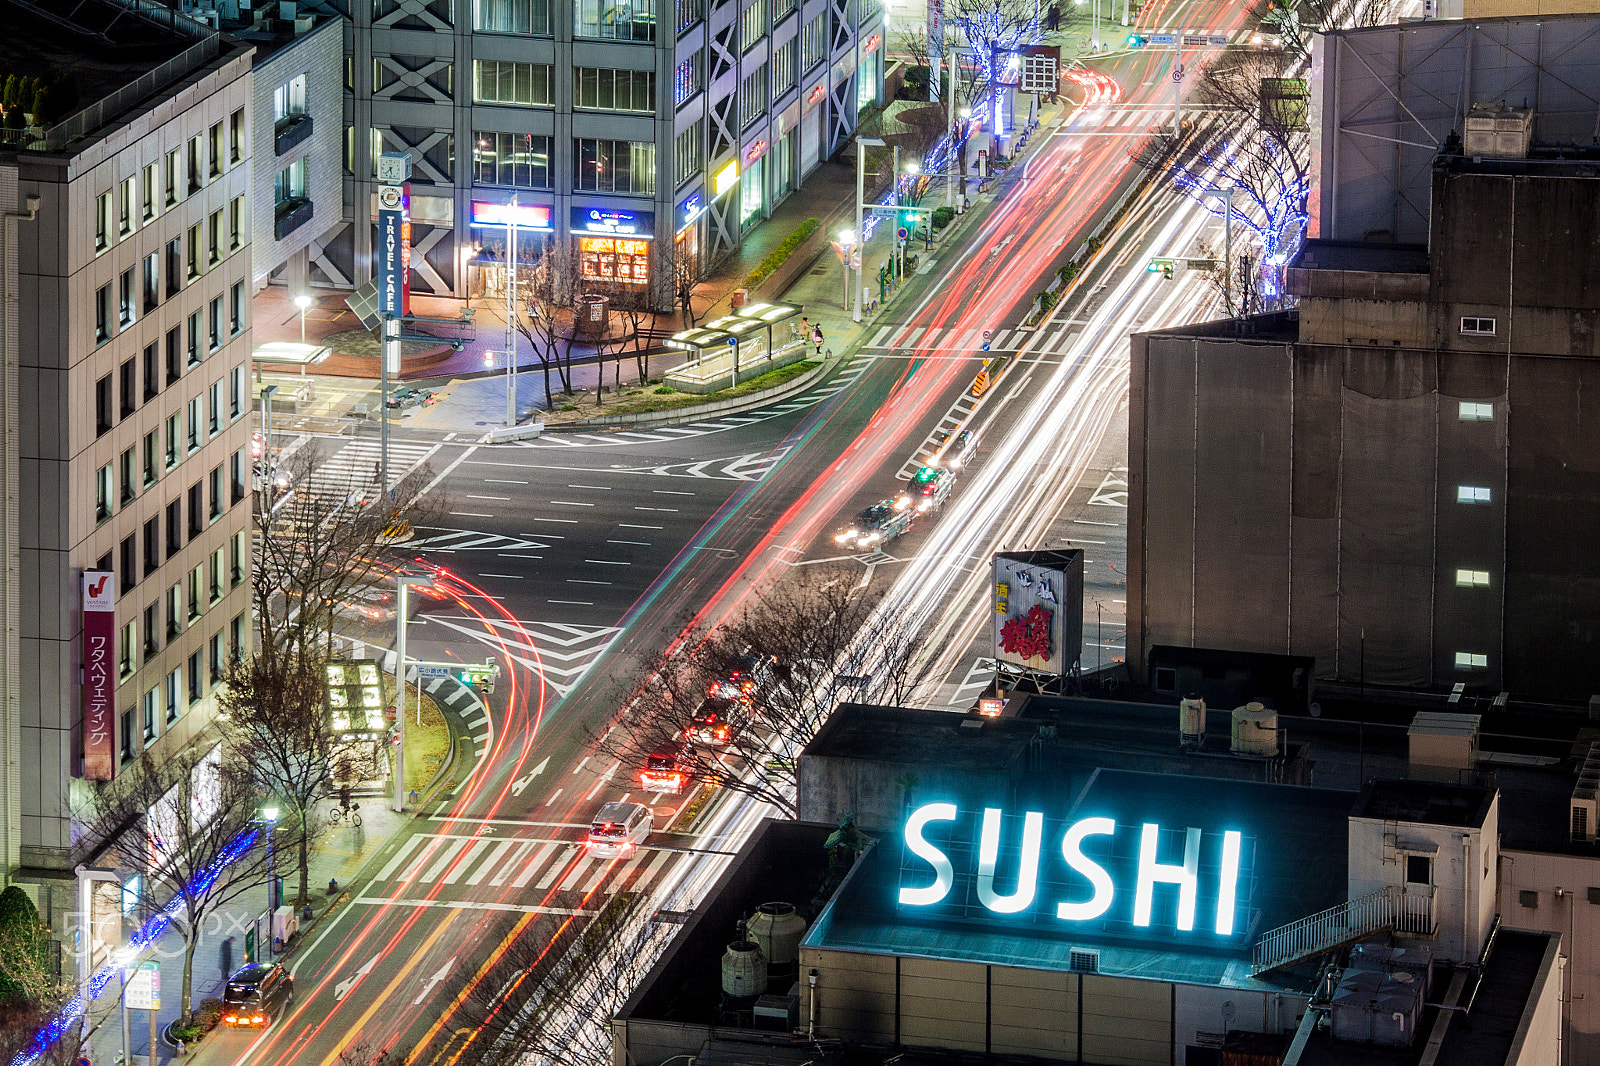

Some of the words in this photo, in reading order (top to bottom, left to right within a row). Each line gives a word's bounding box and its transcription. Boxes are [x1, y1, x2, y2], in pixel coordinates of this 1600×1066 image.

[386, 215, 395, 271] TRAVEL
[386, 274, 395, 312] CAFE
[90, 636, 108, 746] ワタベウェディング
[898, 802, 1241, 936] SUSHI
